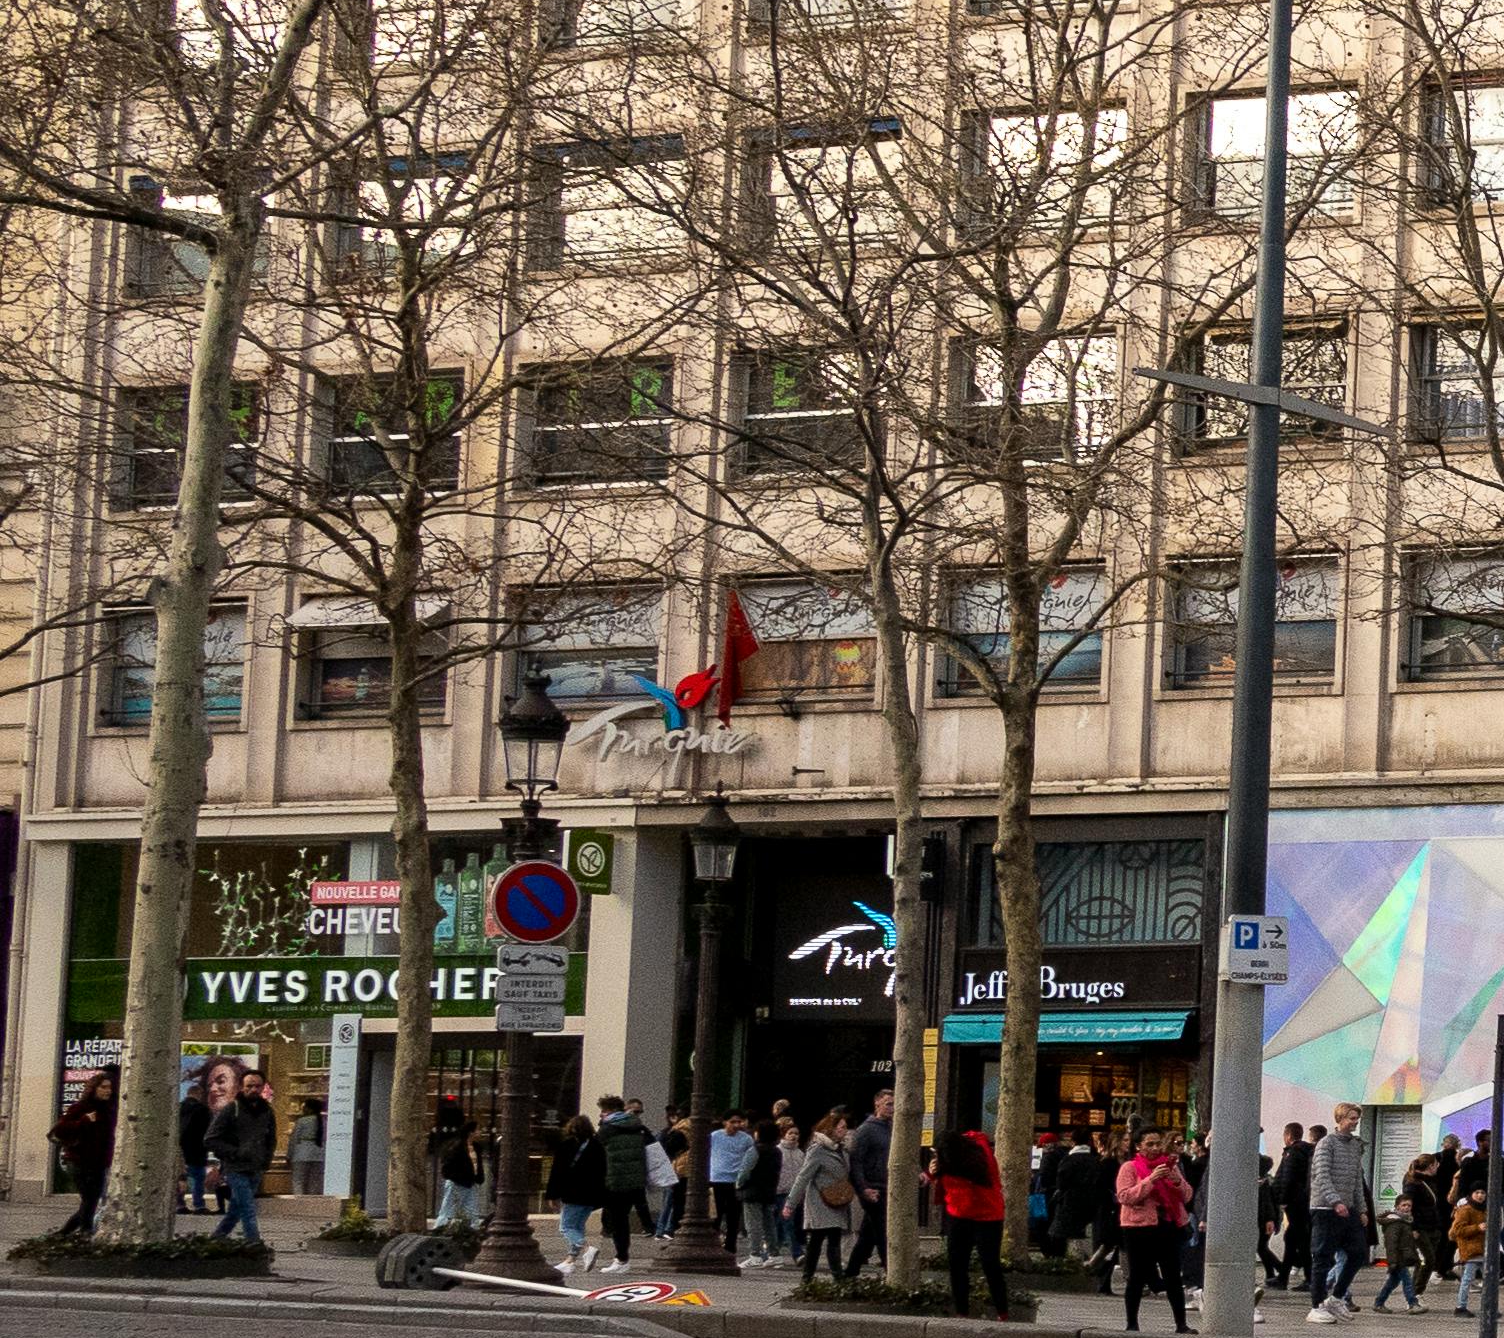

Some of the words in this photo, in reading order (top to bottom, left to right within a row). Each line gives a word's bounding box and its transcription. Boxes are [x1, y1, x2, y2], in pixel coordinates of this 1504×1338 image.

[566, 700, 758, 788] Turquie
[316, 885, 377, 900] NOUVELLE
[1240, 925, 1254, 947] P
[788, 923, 897, 998] Turq
[201, 969, 308, 1003] YVES
[510, 980, 553, 988] INTERDIT
[960, 970, 1008, 1005] Jeff
[1040, 965, 1125, 1004] Bruges
[504, 990, 528, 998] SAUF
[532, 990, 558, 998] TAXIS
[66, 1040, 80, 1052] LA
[870, 1061, 893, 1073] 102
[63, 1083, 86, 1092] SANS
